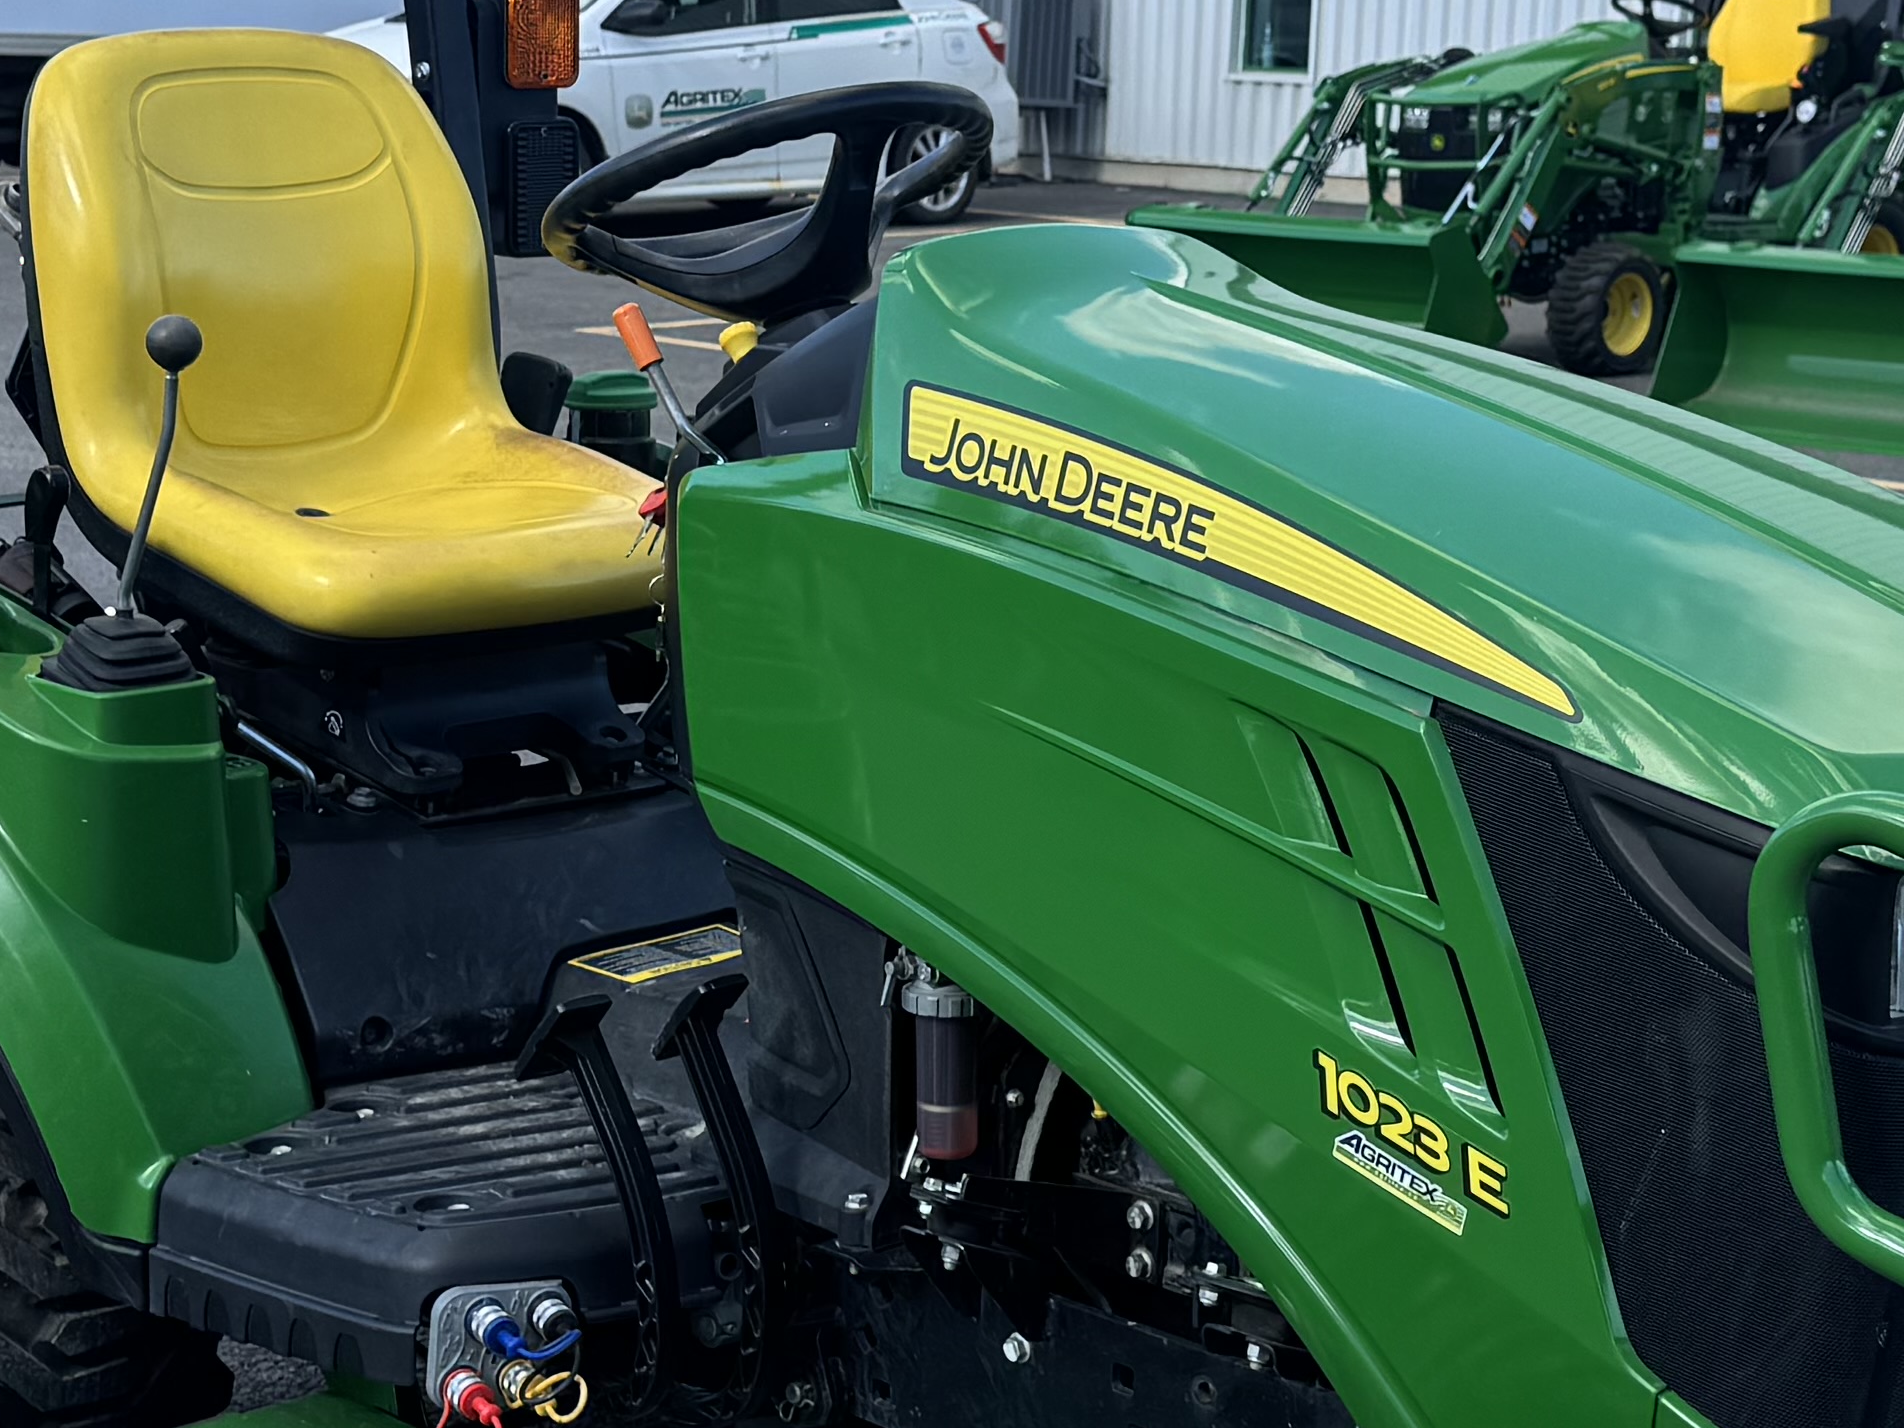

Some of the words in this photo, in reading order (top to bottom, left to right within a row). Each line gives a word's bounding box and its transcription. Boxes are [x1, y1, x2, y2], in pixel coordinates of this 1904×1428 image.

[661, 87, 743, 109] AGRITEX
[928, 417, 1049, 497] JOHN
[1053, 450, 1216, 556] DEERE
[1312, 1047, 1451, 1175] 1023
[1459, 1141, 1511, 1219] E
[1338, 1133, 1439, 1203] AGRITEX
